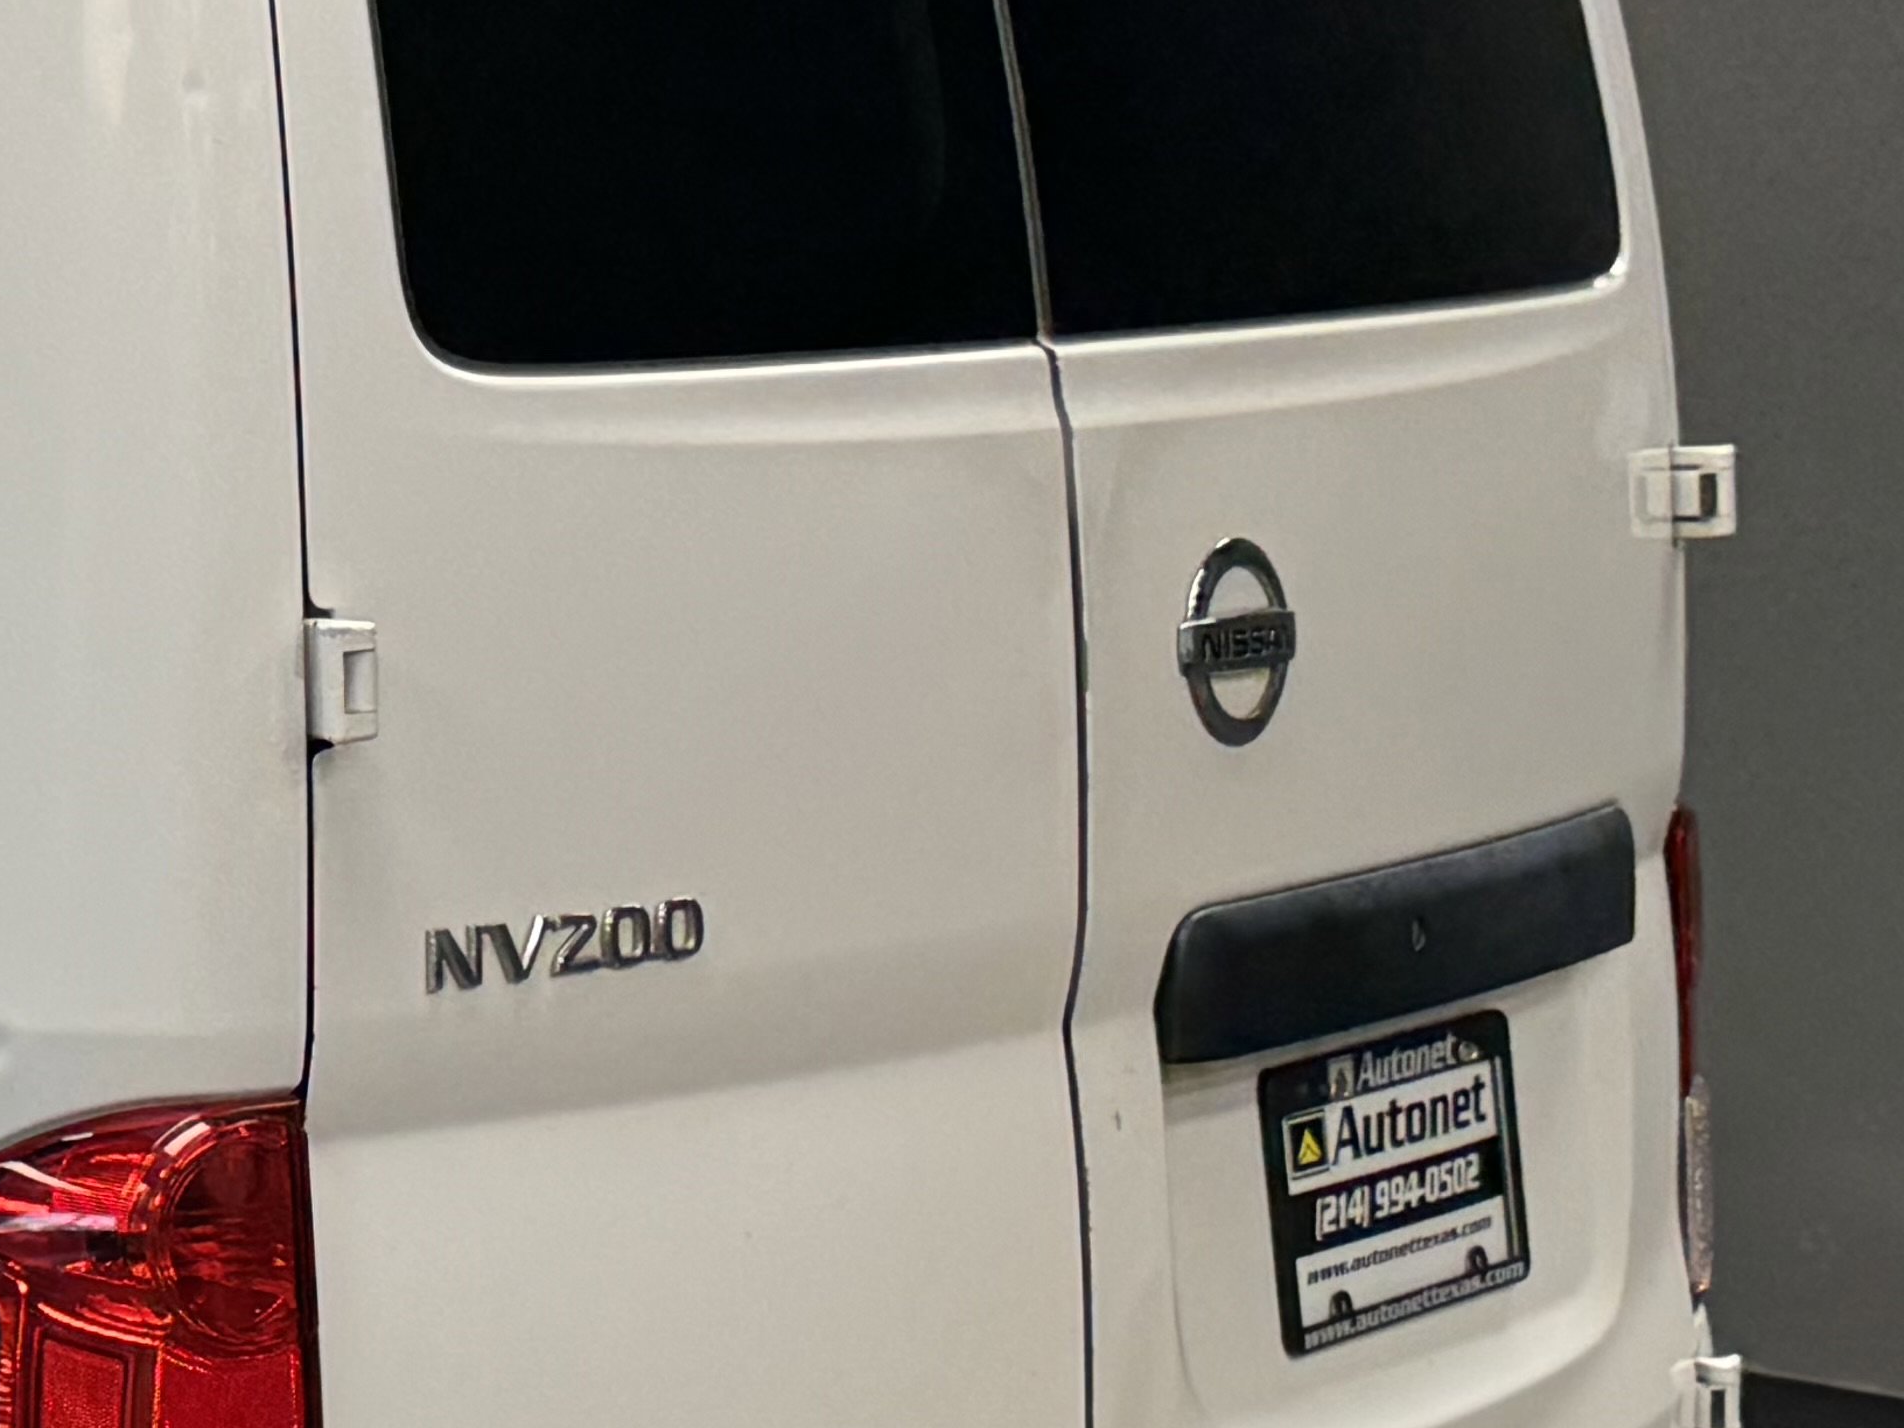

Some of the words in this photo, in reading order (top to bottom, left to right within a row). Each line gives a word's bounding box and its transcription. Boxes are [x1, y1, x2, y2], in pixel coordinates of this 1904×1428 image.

[425, 895, 704, 994] NV200
[1356, 1031, 1457, 1091] Autonet
[1331, 1074, 1487, 1165] Autonet
[1315, 1183, 1371, 1241] (214)
[1375, 1153, 1481, 1220] 994-0502
[1306, 1215, 1493, 1286] www.autonettexas.com
[1304, 1261, 1525, 1351] www.autonettexas.com
